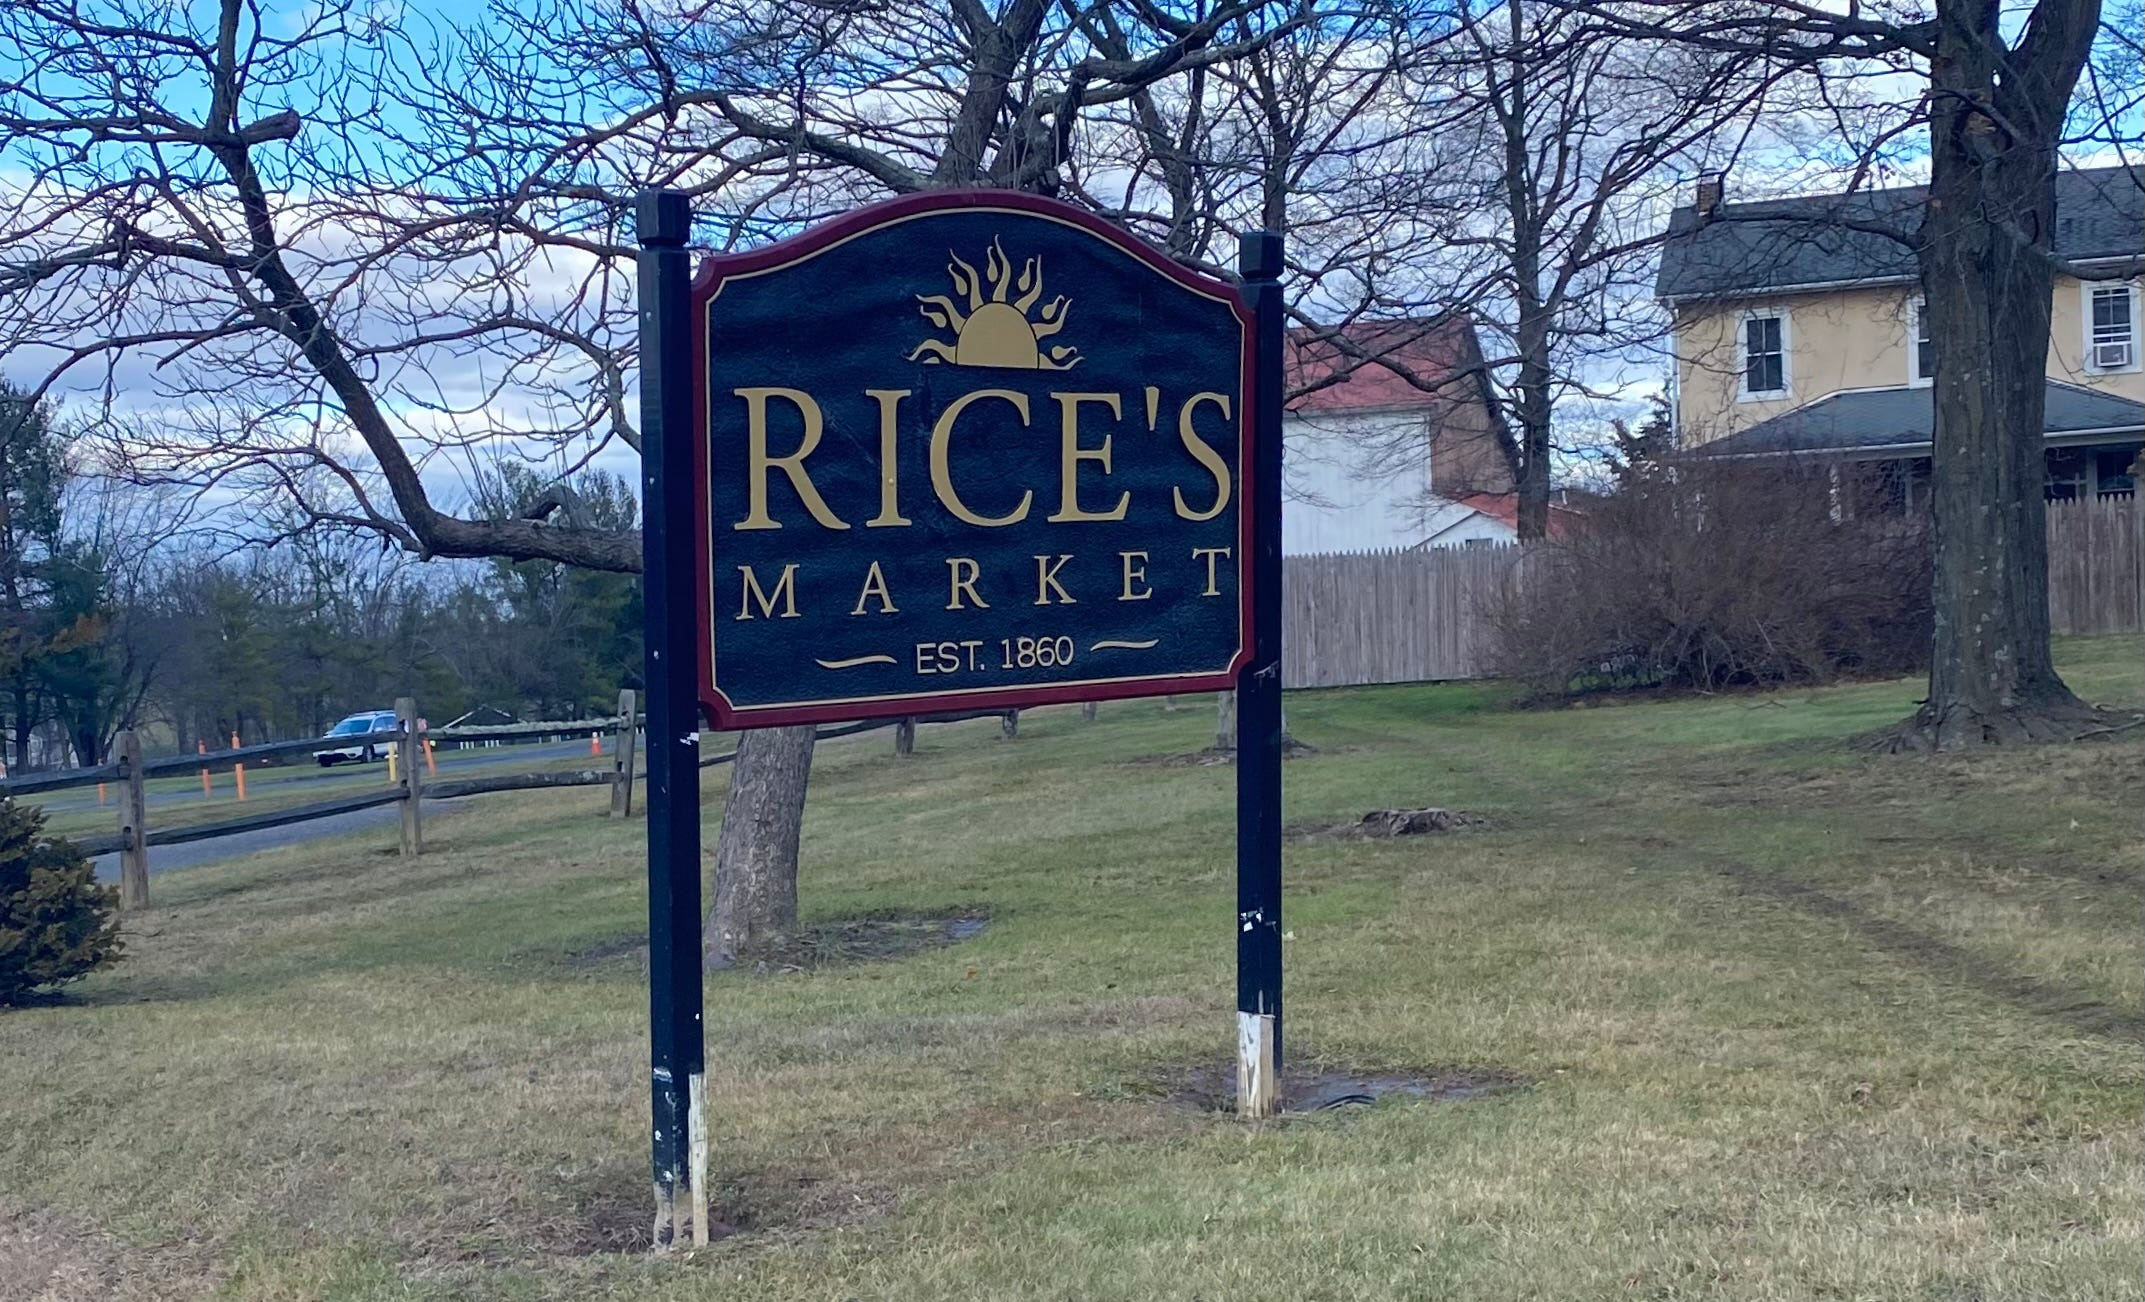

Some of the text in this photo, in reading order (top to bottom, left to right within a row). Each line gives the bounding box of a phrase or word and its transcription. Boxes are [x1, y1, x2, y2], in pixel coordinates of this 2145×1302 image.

[733, 386, 1233, 531] RICE'S
[735, 547, 1231, 621] MARKET
[916, 635, 1075, 675] EST. 1860
